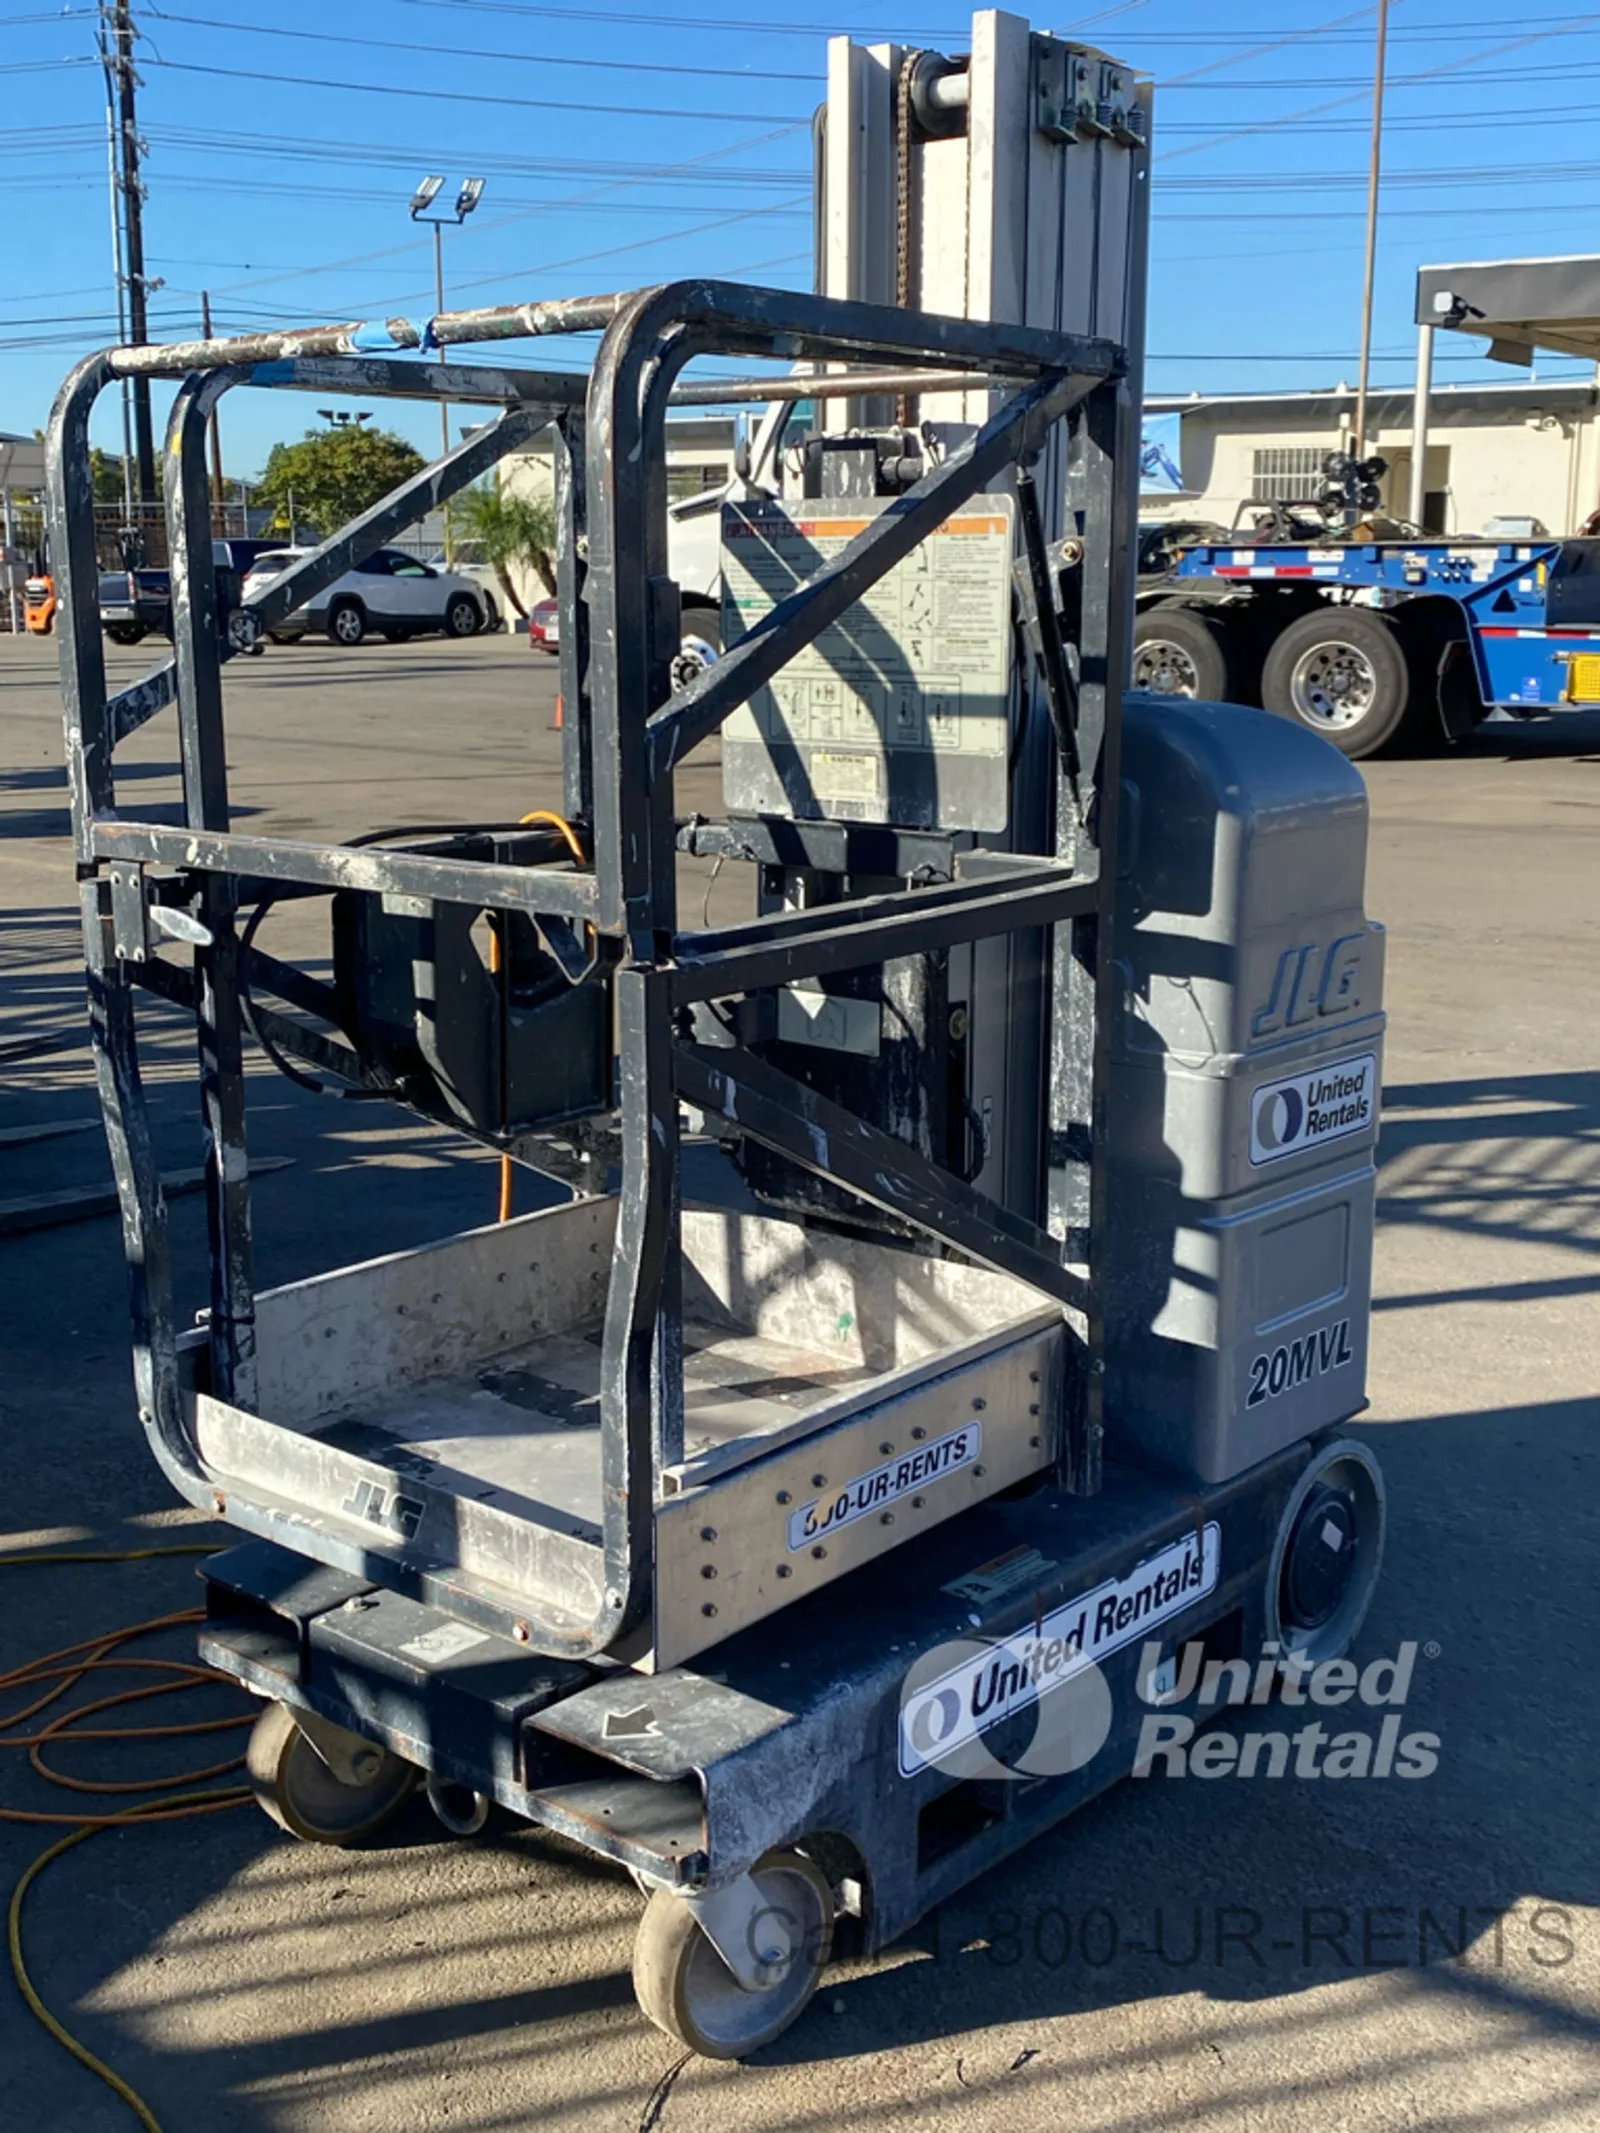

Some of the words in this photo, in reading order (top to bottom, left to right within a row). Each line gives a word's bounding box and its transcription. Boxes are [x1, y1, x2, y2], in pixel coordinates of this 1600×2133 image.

[1305, 1095, 1369, 1138] Rentals
[1307, 1065, 1367, 1108] United
[1246, 1318, 1353, 1409] 20MVL
[341, 1476, 427, 1541] JLG
[971, 1611, 1087, 1718] United
[1093, 1550, 1205, 1646] Rentals
